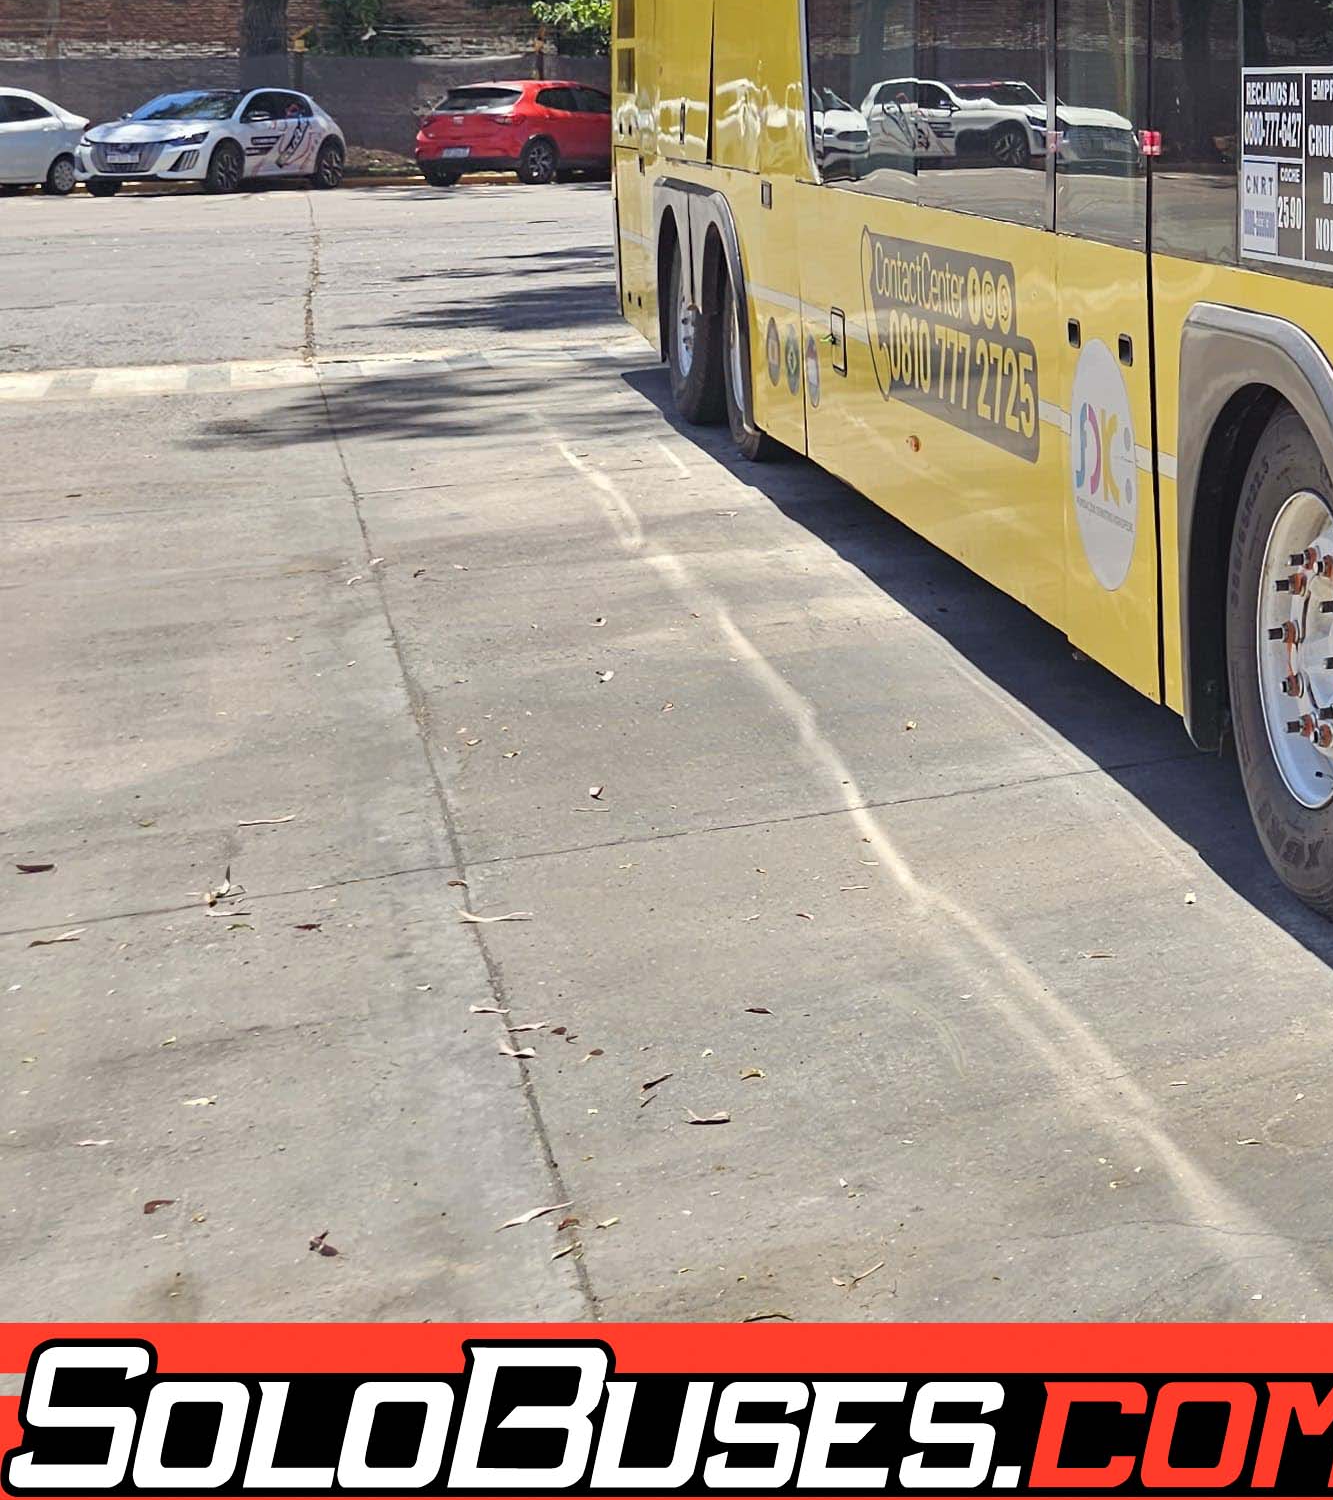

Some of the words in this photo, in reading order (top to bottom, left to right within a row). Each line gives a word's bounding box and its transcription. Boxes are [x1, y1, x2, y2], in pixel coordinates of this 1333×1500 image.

[1246, 81, 1288, 106] RECLAMOS
[1288, 80, 1301, 106] AL
[1280, 167, 1302, 184] COCHE
[1278, 196, 1302, 230] 2590
[874, 241, 965, 320] ContactCenter
[888, 308, 932, 394] 0810
[935, 323, 971, 411] 777
[976, 337, 1036, 439] 2725
